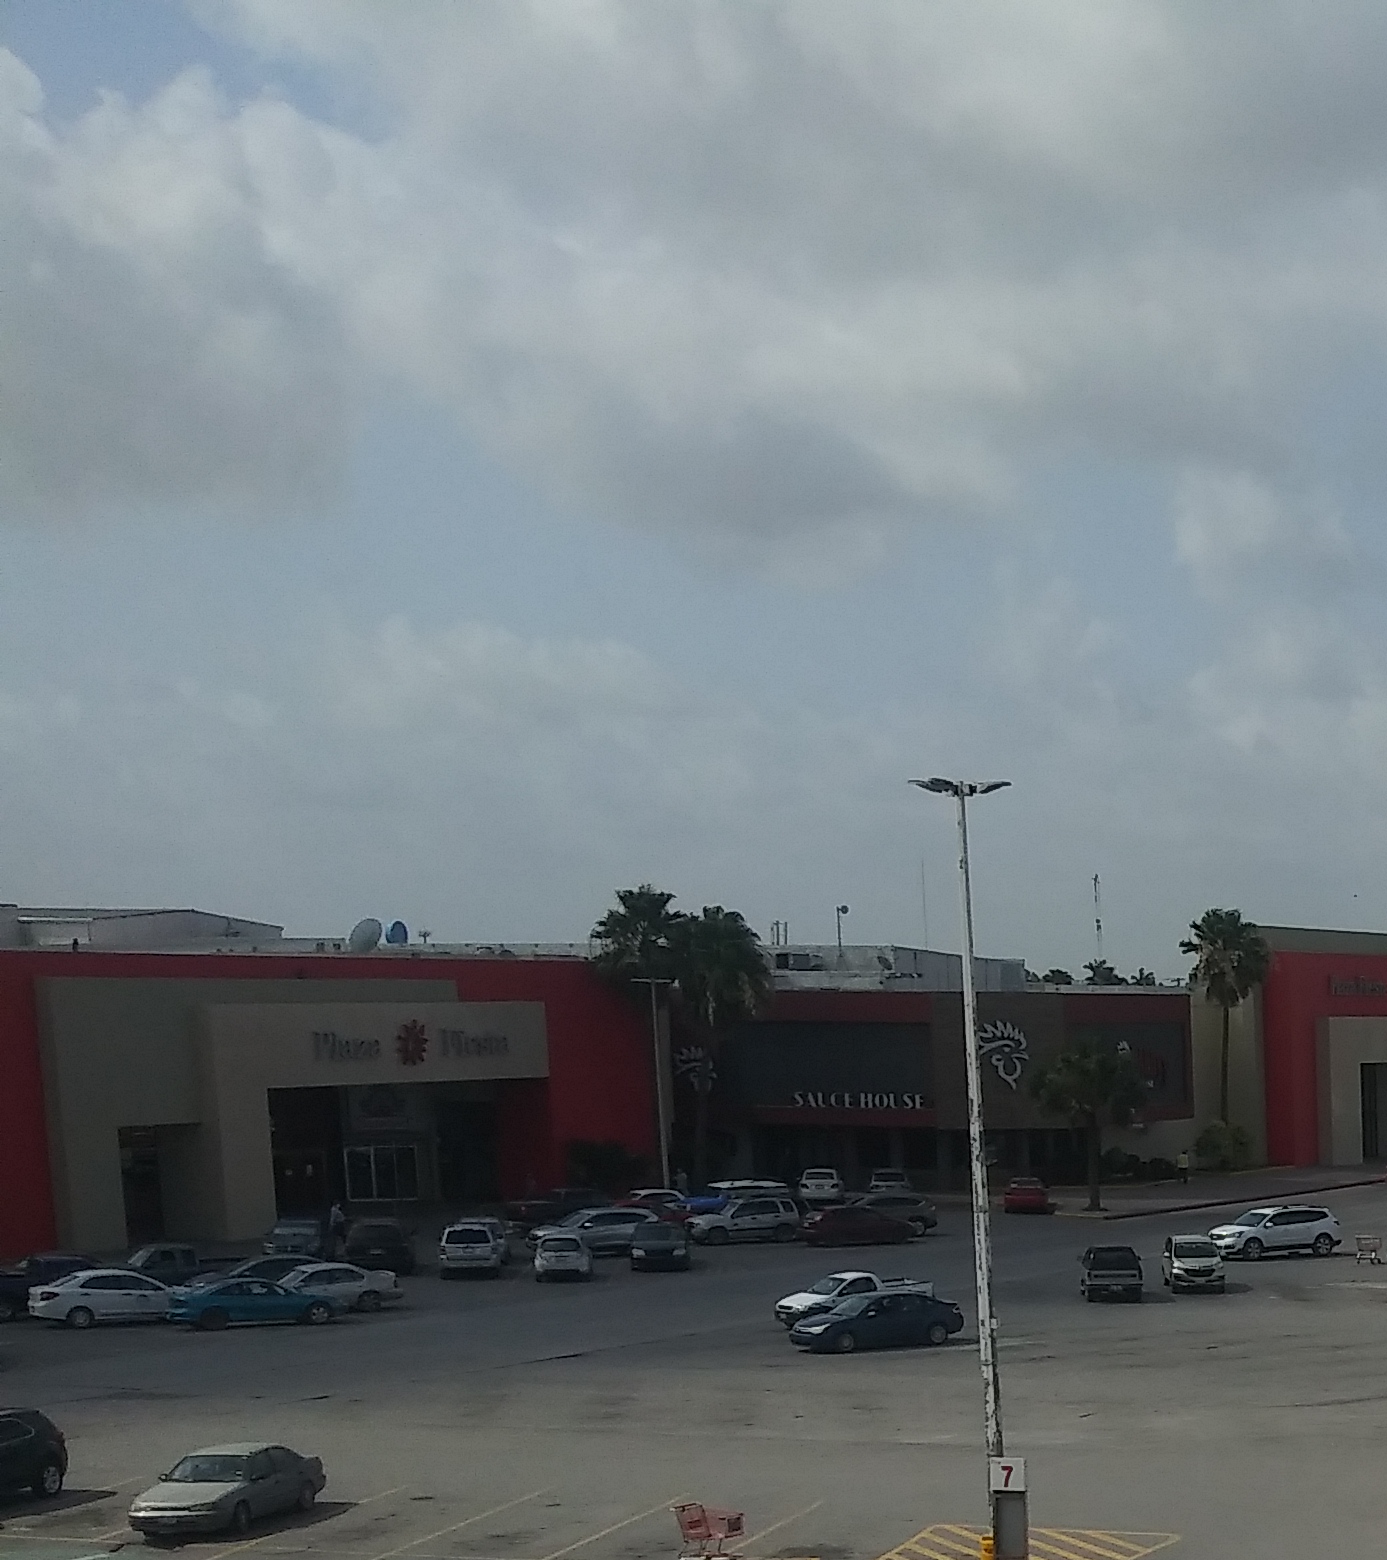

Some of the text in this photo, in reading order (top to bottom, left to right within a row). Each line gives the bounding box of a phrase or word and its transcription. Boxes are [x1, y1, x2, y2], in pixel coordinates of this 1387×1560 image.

[793, 1091, 925, 1109] SAUCE HOUSE
[1000, 1465, 1014, 1488] 7
